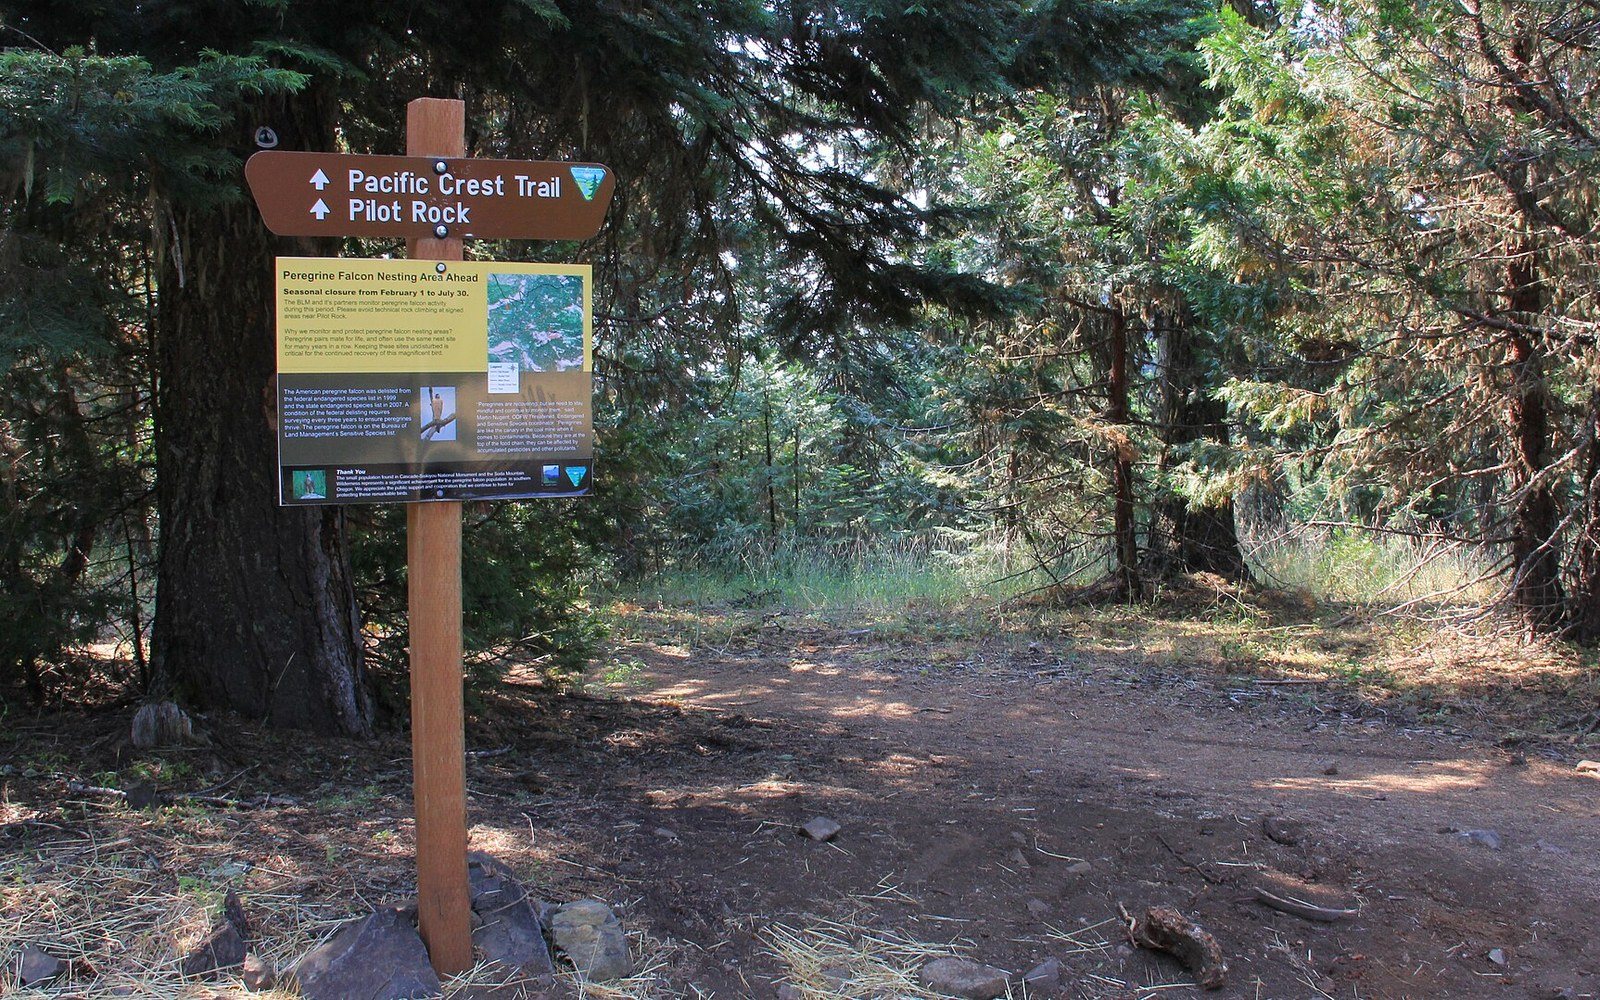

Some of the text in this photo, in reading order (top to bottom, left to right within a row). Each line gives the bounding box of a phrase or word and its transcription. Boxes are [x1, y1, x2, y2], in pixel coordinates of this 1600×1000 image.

[348, 169, 561, 198] Pacific Crest Trail
[349, 199, 470, 224] Pilot Rock
[284, 271, 478, 283] Peregrine Falcon Nesting Area Ahead
[380, 289, 418, 298] February
[437, 290, 455, 298] July
